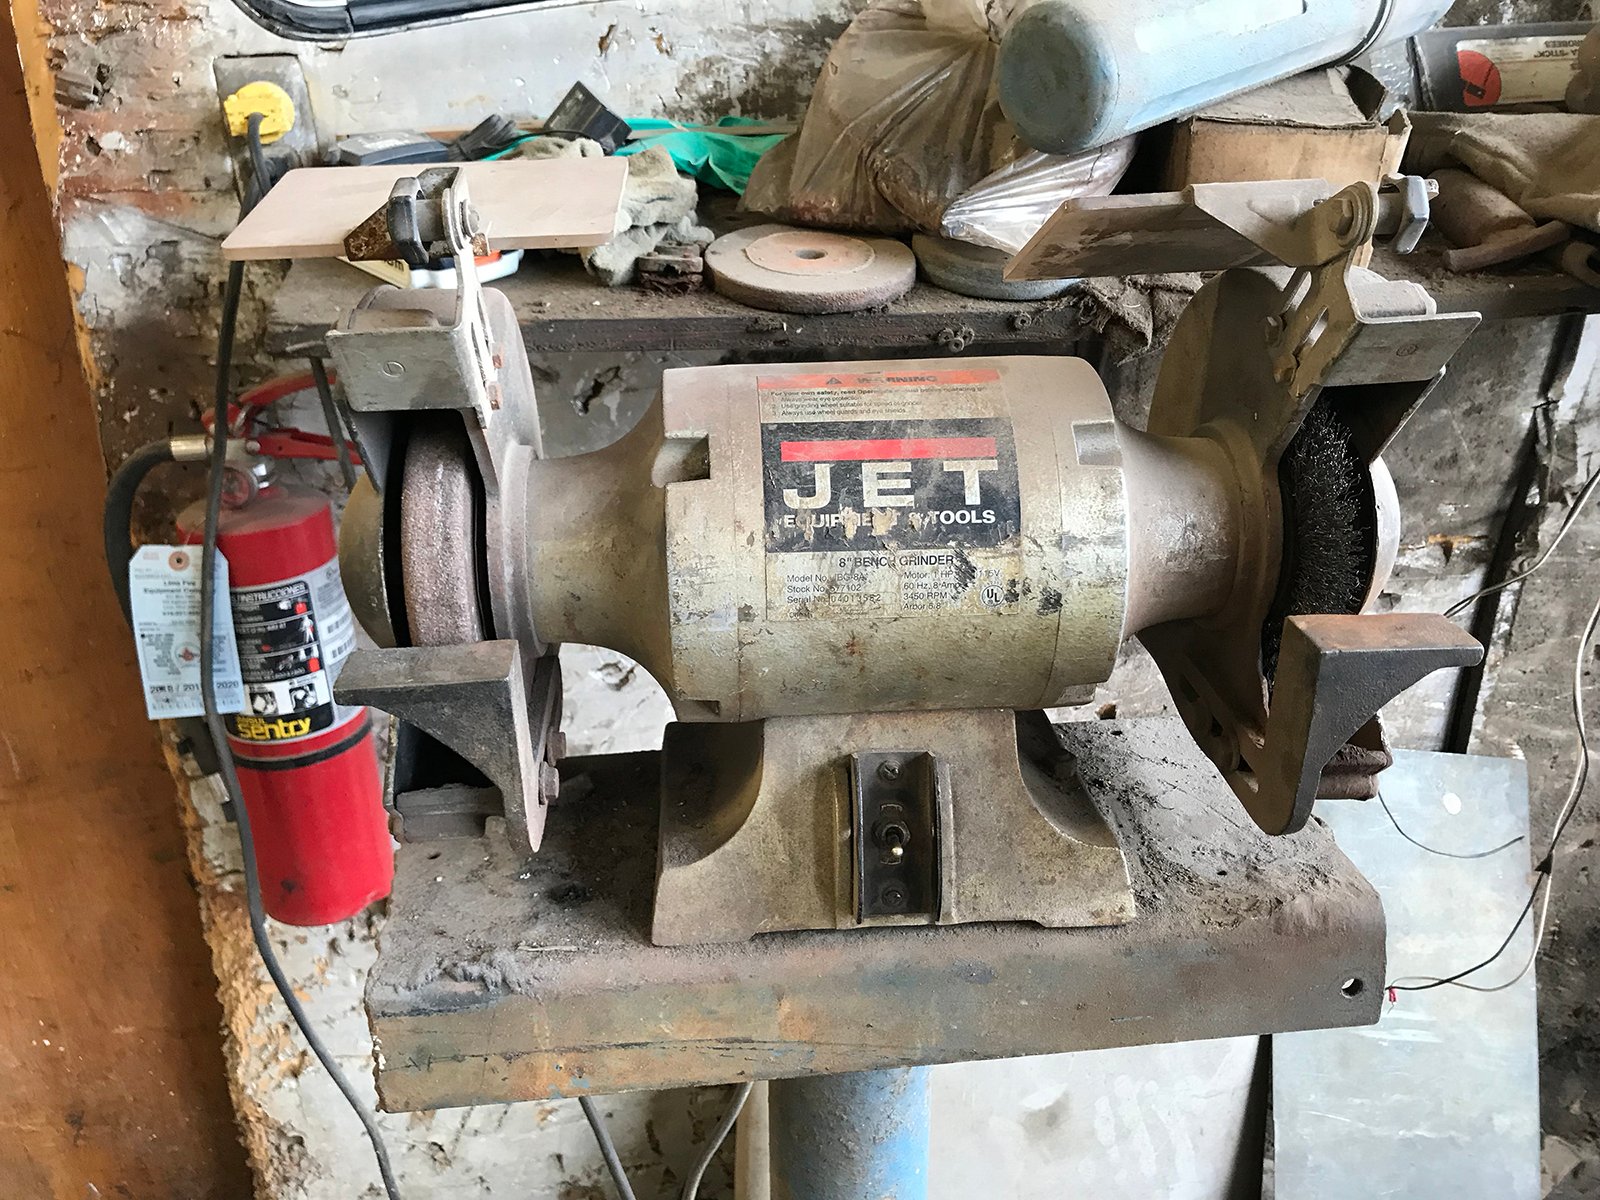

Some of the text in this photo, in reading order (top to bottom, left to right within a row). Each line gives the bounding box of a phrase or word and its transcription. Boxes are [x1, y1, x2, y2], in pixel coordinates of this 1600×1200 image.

[817, 408, 836, 416] wheel
[836, 408, 858, 416] guards
[783, 459, 999, 509] JET
[784, 511, 900, 529] EUIPET
[929, 509, 996, 526] TOOLS
[899, 554, 954, 566] GRINDER
[940, 569, 955, 578] HP
[786, 574, 812, 583] Model
[786, 585, 811, 593] Stock
[903, 581, 915, 590] 60
[932, 581, 939, 590] 8
[786, 595, 811, 604] Serial
[903, 591, 948, 601] 3450 RPM
